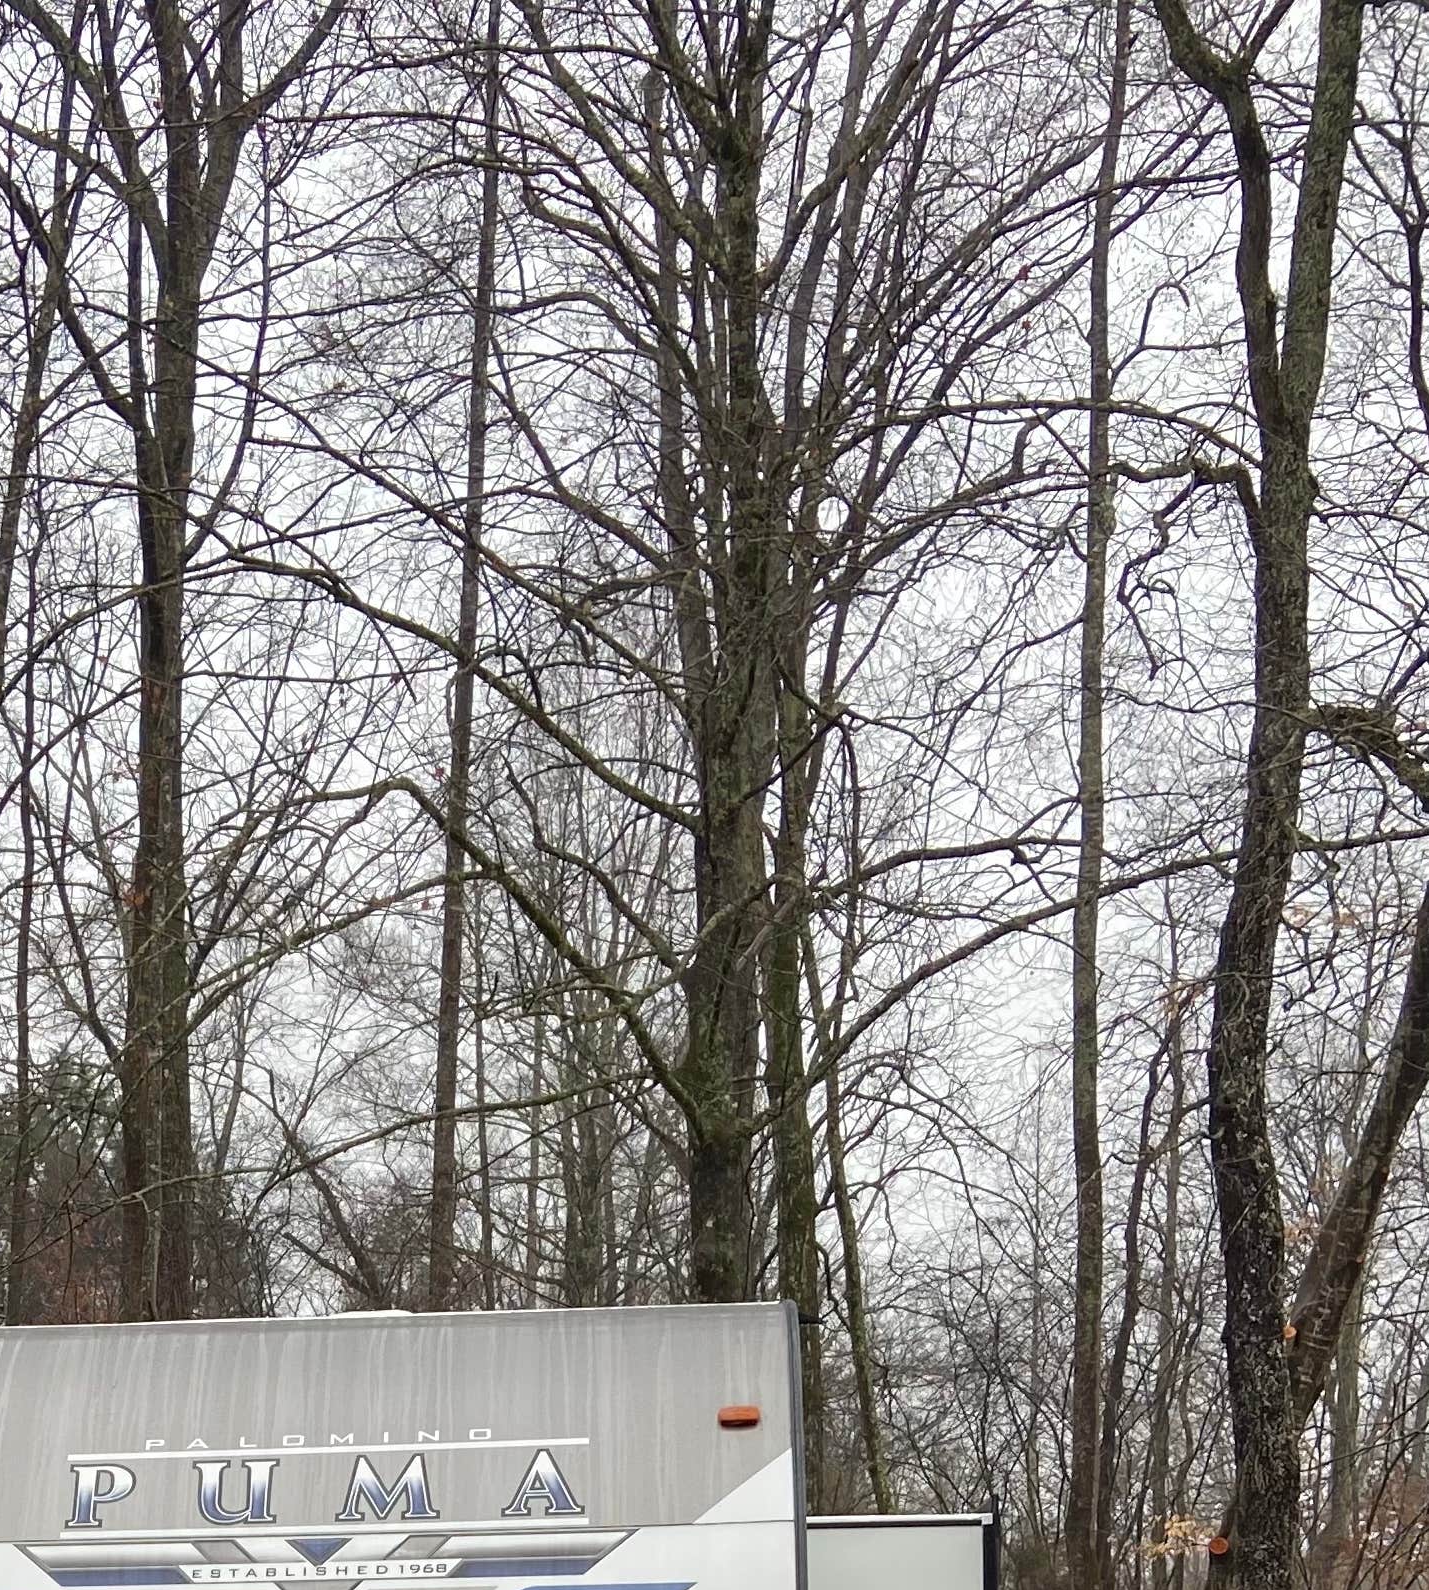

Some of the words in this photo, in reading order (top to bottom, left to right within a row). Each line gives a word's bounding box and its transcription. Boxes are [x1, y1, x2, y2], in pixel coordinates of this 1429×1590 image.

[144, 1428, 492, 1451] PALOMINO
[64, 1448, 586, 1529] PUMA
[191, 1563, 389, 1580] ESTABLISHED
[398, 1562, 448, 1576] 1968
